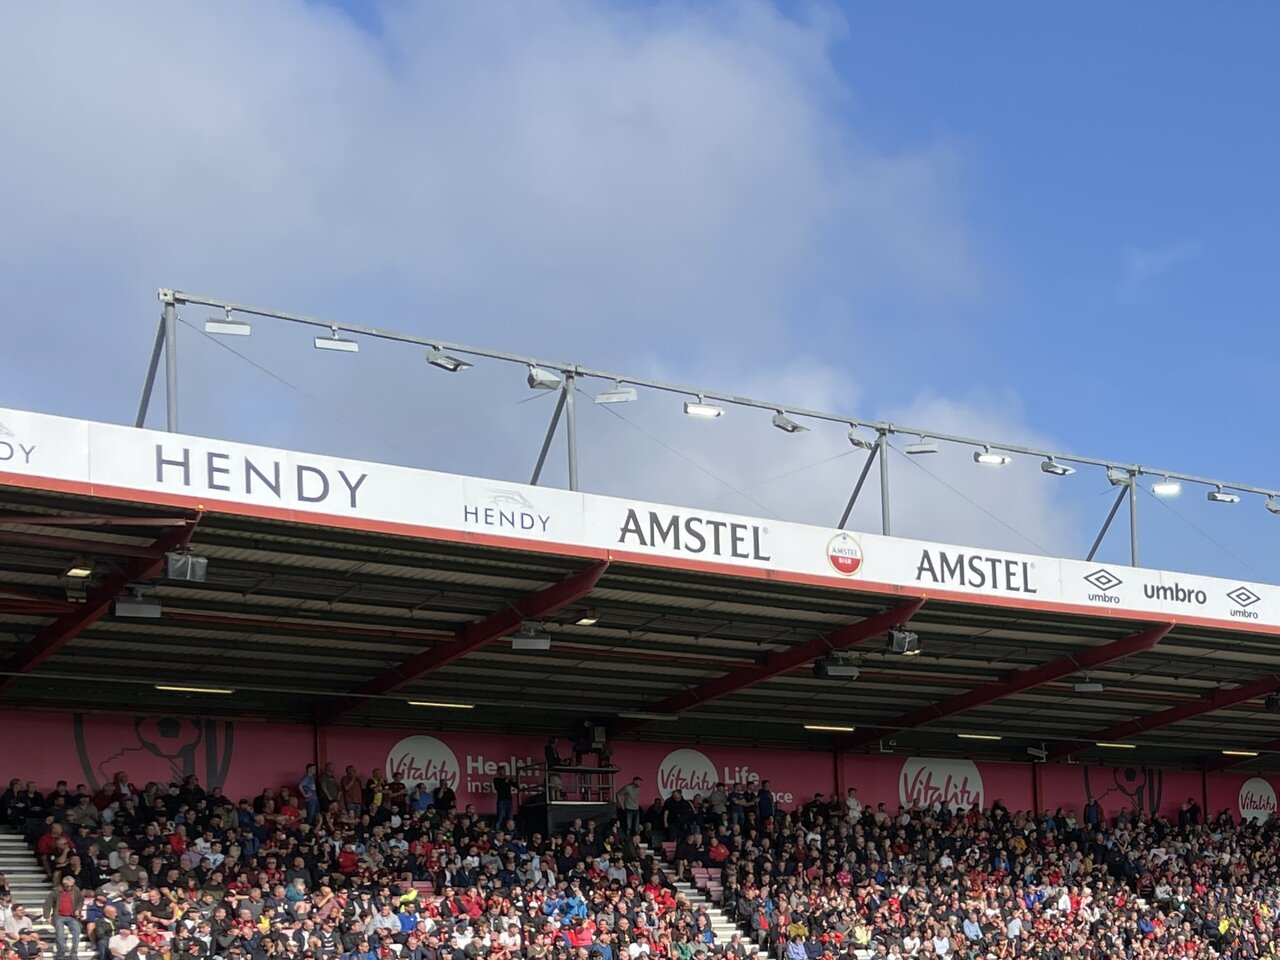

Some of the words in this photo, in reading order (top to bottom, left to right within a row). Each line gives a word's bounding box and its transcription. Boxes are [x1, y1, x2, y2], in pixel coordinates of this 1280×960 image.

[155, 444, 367, 508] HENDY
[464, 505, 550, 532] HENDY
[617, 508, 771, 562] AMSTEL
[916, 549, 1037, 594] AMSTEL
[1088, 592, 1120, 604] umbro
[1143, 583, 1207, 605] umbro
[1230, 608, 1259, 620] umbro
[390, 752, 456, 786] Vitality
[661, 765, 717, 791] Vitality
[725, 767, 759, 785] Life
[904, 767, 980, 805] Vitality
[1241, 790, 1276, 812] Vitality
